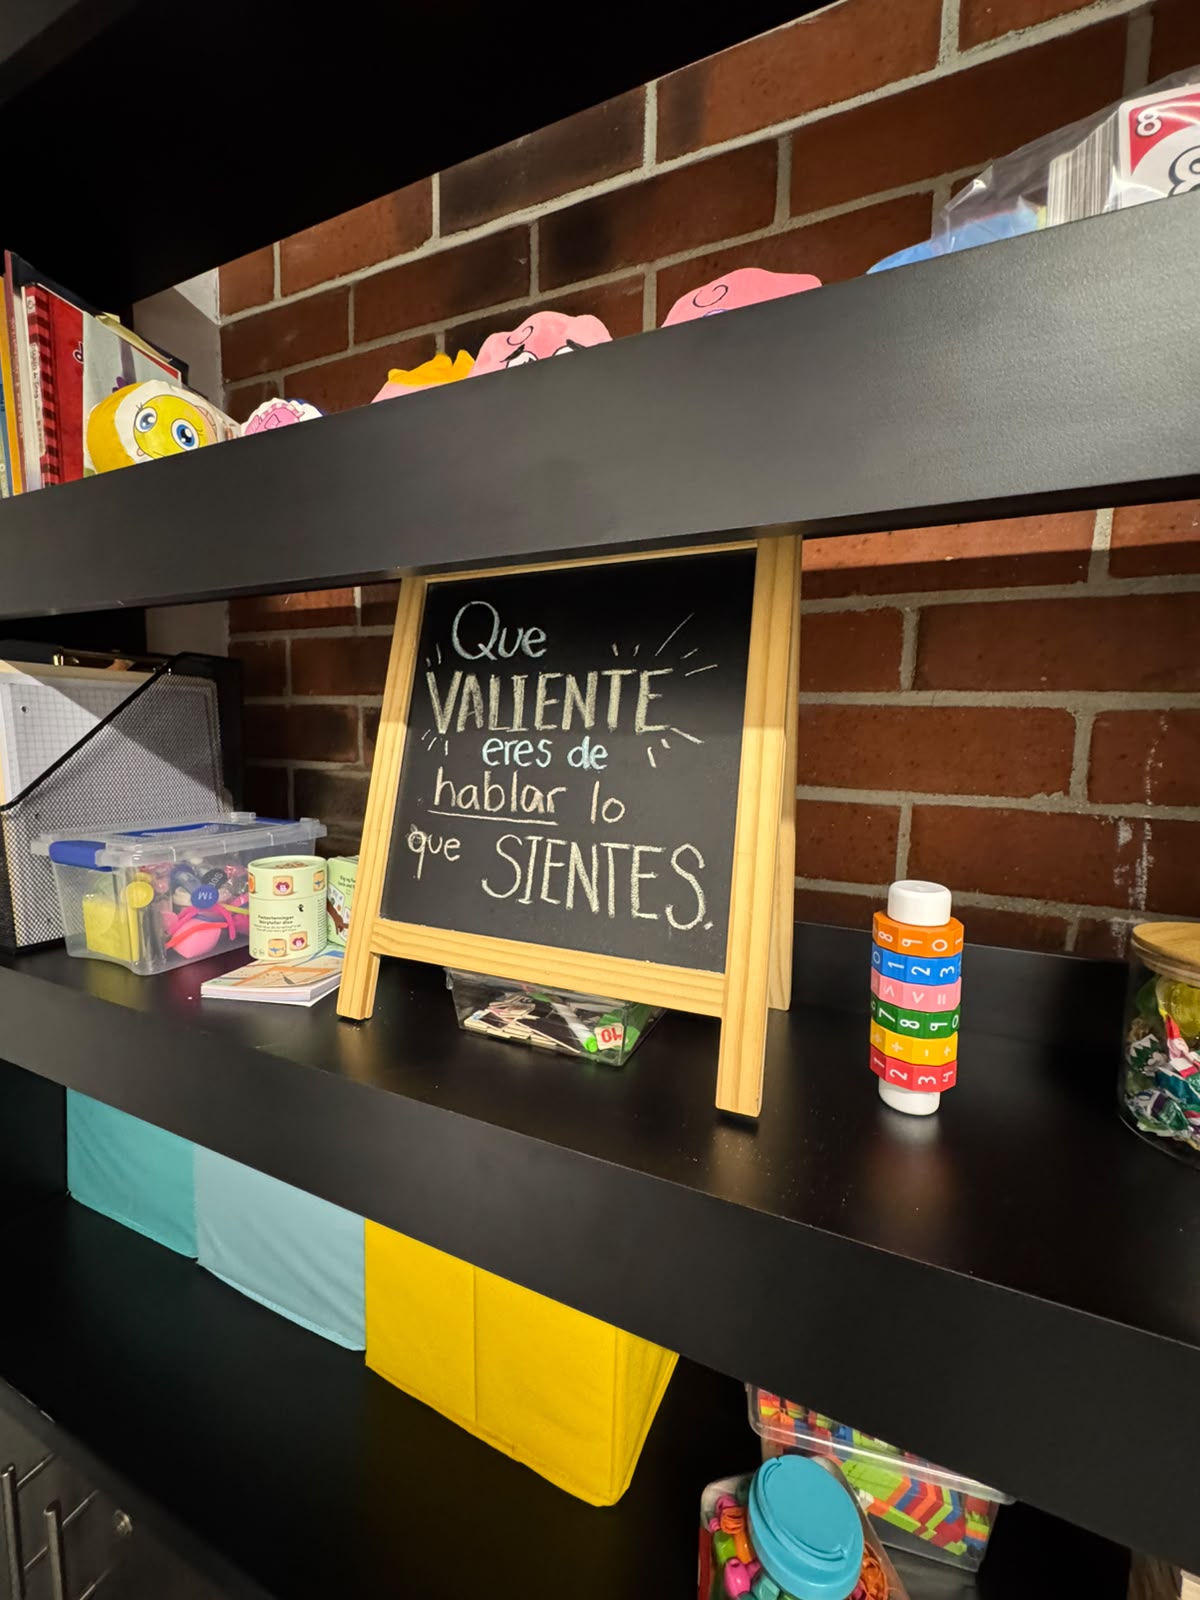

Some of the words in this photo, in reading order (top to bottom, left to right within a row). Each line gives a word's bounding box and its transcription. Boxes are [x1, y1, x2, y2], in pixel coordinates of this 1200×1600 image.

[1136, 110, 1162, 136] 8
[451, 600, 548, 661] Que
[425, 668, 674, 733] VALIENTE
[481, 738, 553, 768] eres
[566, 735, 609, 770] de
[433, 765, 568, 814] hablar
[590, 780, 626, 824] lo
[407, 828, 462, 880] que
[481, 833, 714, 931] SIENTES.
